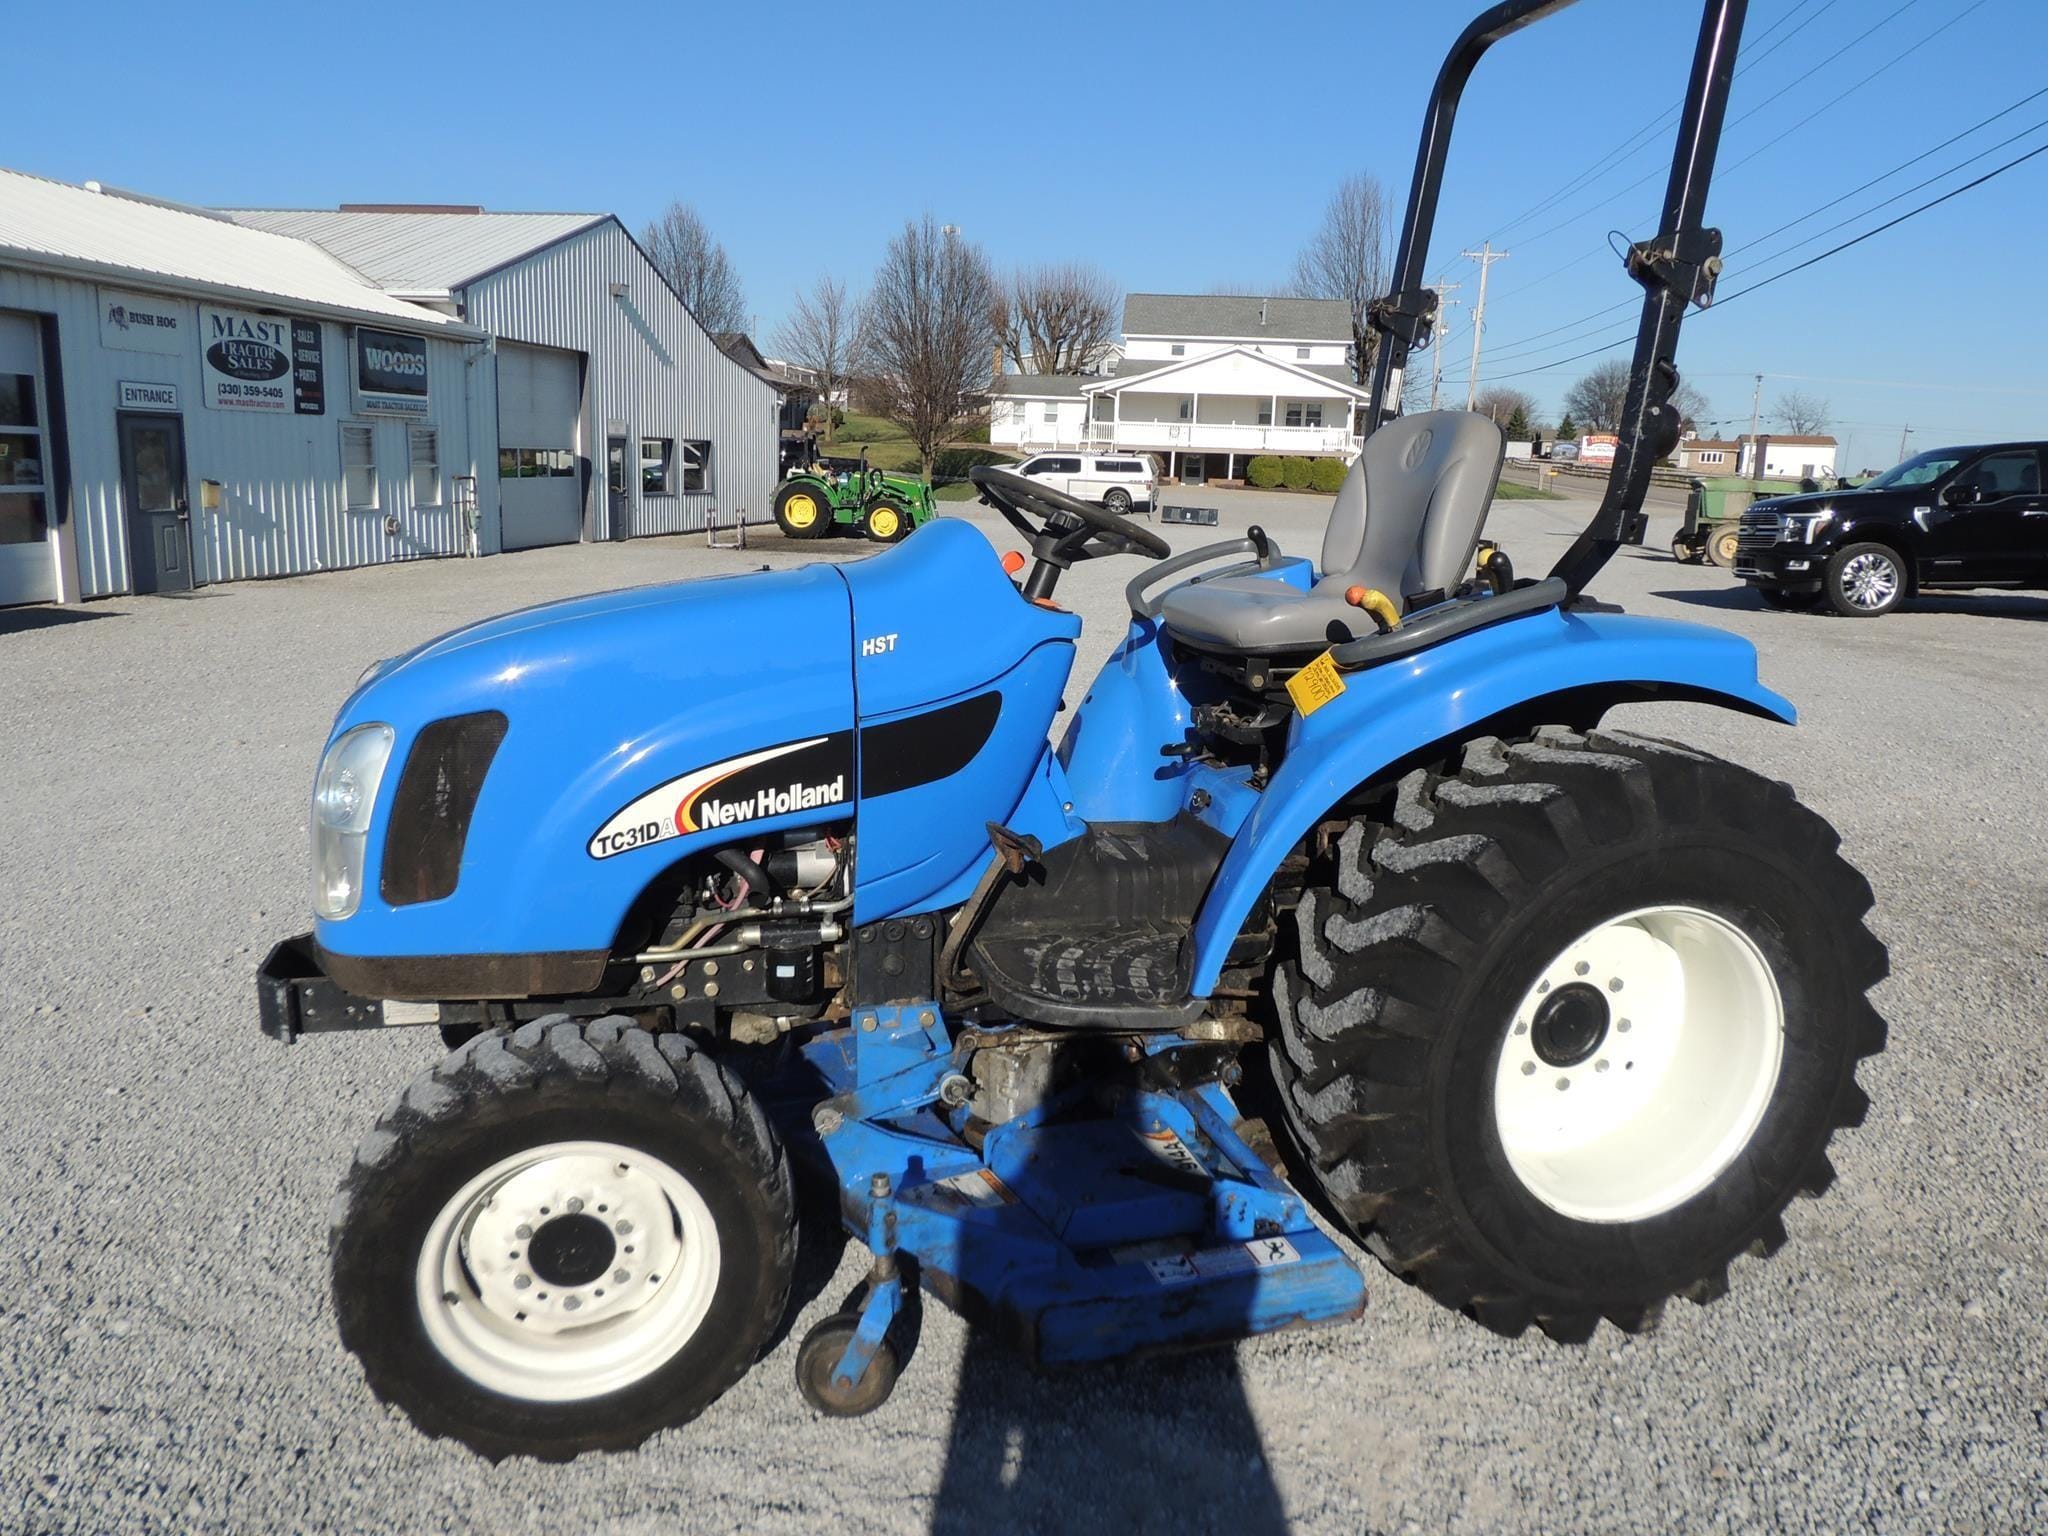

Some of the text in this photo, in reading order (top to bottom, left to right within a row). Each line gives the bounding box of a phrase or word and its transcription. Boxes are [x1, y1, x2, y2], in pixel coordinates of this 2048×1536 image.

[129, 312, 177, 329] BUSH HOG
[211, 314, 285, 346] MAST
[220, 341, 276, 360] TRACTOR
[227, 355, 273, 371] SALES
[366, 347, 425, 376] WOODS
[125, 388, 174, 404] ENTRANCE
[218, 383, 284, 399] (330) 359-5405
[862, 633, 898, 657] HST
[701, 798, 755, 830] New
[757, 774, 844, 818] Holland
